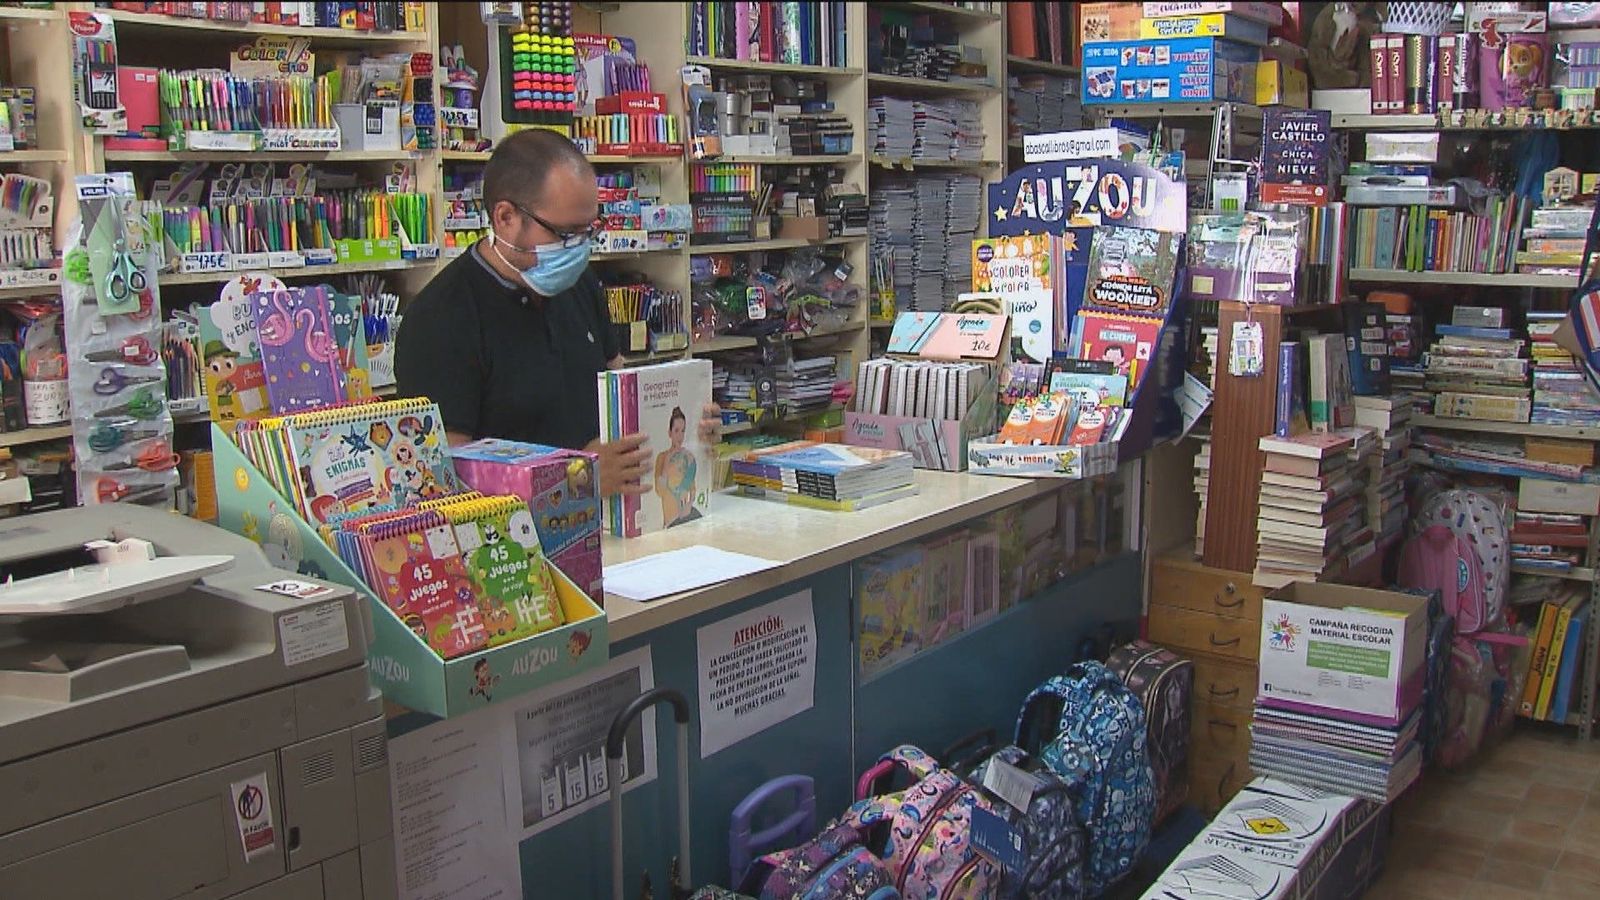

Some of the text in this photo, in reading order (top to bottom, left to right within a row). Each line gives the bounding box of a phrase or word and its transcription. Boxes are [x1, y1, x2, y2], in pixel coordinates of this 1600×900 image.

[1280, 122, 1318, 131] JAVIER
[1272, 132, 1325, 142] CASTILLO
[1025, 138, 1111, 156] abascallibros@gmail.com
[1282, 151, 1313, 159] CHICA
[1278, 165, 1316, 174] NIEVE
[1011, 165, 1157, 227] AUZOU
[993, 265, 1029, 278] COLOREA
[325, 457, 366, 479] ENIGMAS
[490, 545, 508, 562] 45
[413, 563, 433, 581] 45
[1309, 618, 1393, 636] CAMPAÑA RECOGIDA
[1311, 628, 1391, 644] MATERIAL ESCOLAR
[512, 646, 558, 676] AUZOU
[709, 671, 718, 680] UN
[743, 656, 754, 666] POR
[755, 650, 772, 662] HABER
[773, 637, 802, 655] SOLICITADO
[710, 658, 717, 668] LA
[746, 666, 753, 676] DE
[776, 651, 795, 664] PASADA
[796, 648, 803, 656] LA
[370, 655, 410, 682] AUZOU
[710, 656, 807, 702] FECHA DE ENTREGA INDICADA SUPONE
[716, 702, 724, 712] LA
[725, 697, 734, 707] NO
[769, 680, 776, 689] DE
[777, 678, 783, 686] LA
[734, 699, 759, 716] MUCHAS
[592, 772, 604, 790] 15
[570, 782, 582, 801] 15
[548, 794, 555, 811] 5
